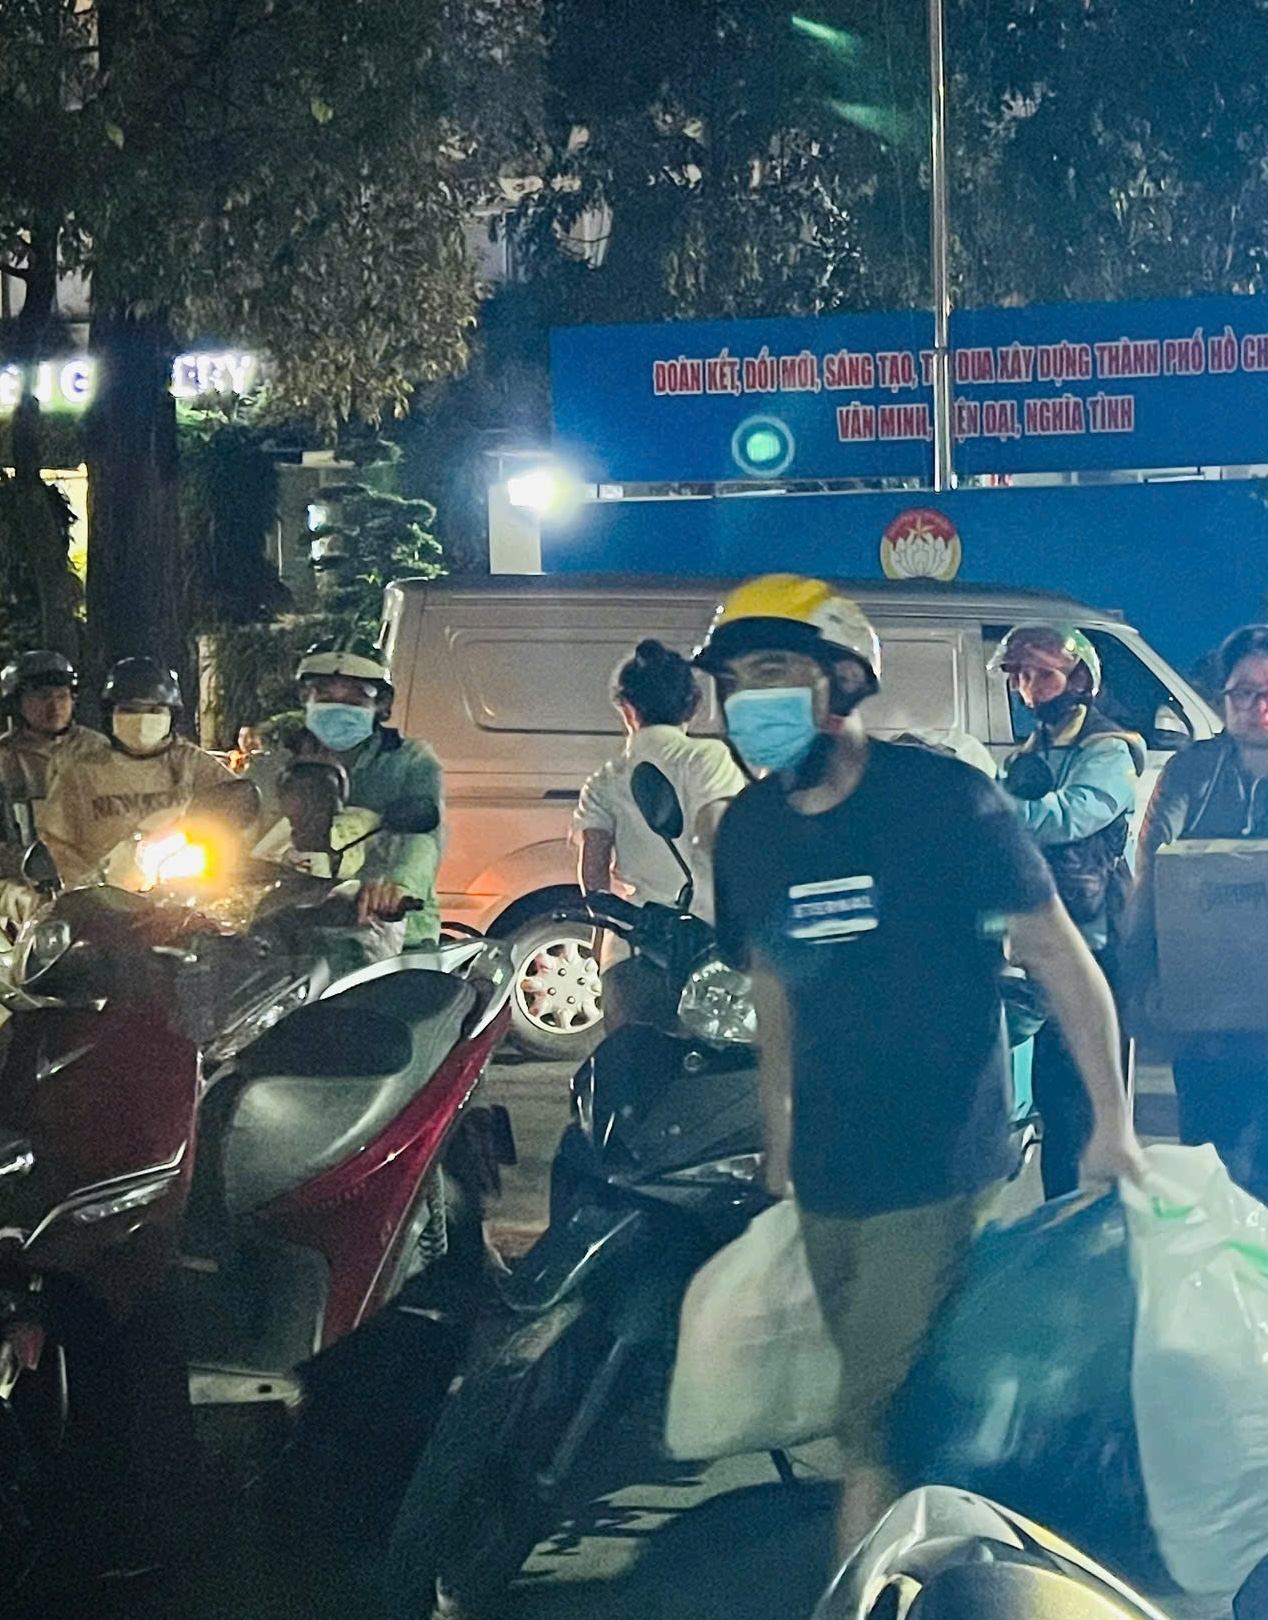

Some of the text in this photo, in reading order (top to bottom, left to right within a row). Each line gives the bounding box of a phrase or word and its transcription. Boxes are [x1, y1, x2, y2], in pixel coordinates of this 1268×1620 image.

[705, 347, 741, 397] KẾT,
[824, 348, 874, 391] SÁNG
[876, 351, 918, 393] TẠO,
[997, 341, 1036, 383] XÂY
[1036, 340, 1093, 388] DỰNG
[1094, 336, 1161, 378] THÀNH
[1163, 326, 1205, 377] PHỐ
[1207, 325, 1238, 375] HỒ
[836, 401, 876, 443] VĂN
[878, 403, 934, 442] MINH,
[1024, 393, 1086, 437] NGHĨA
[1087, 391, 1135, 433] TÌNH
